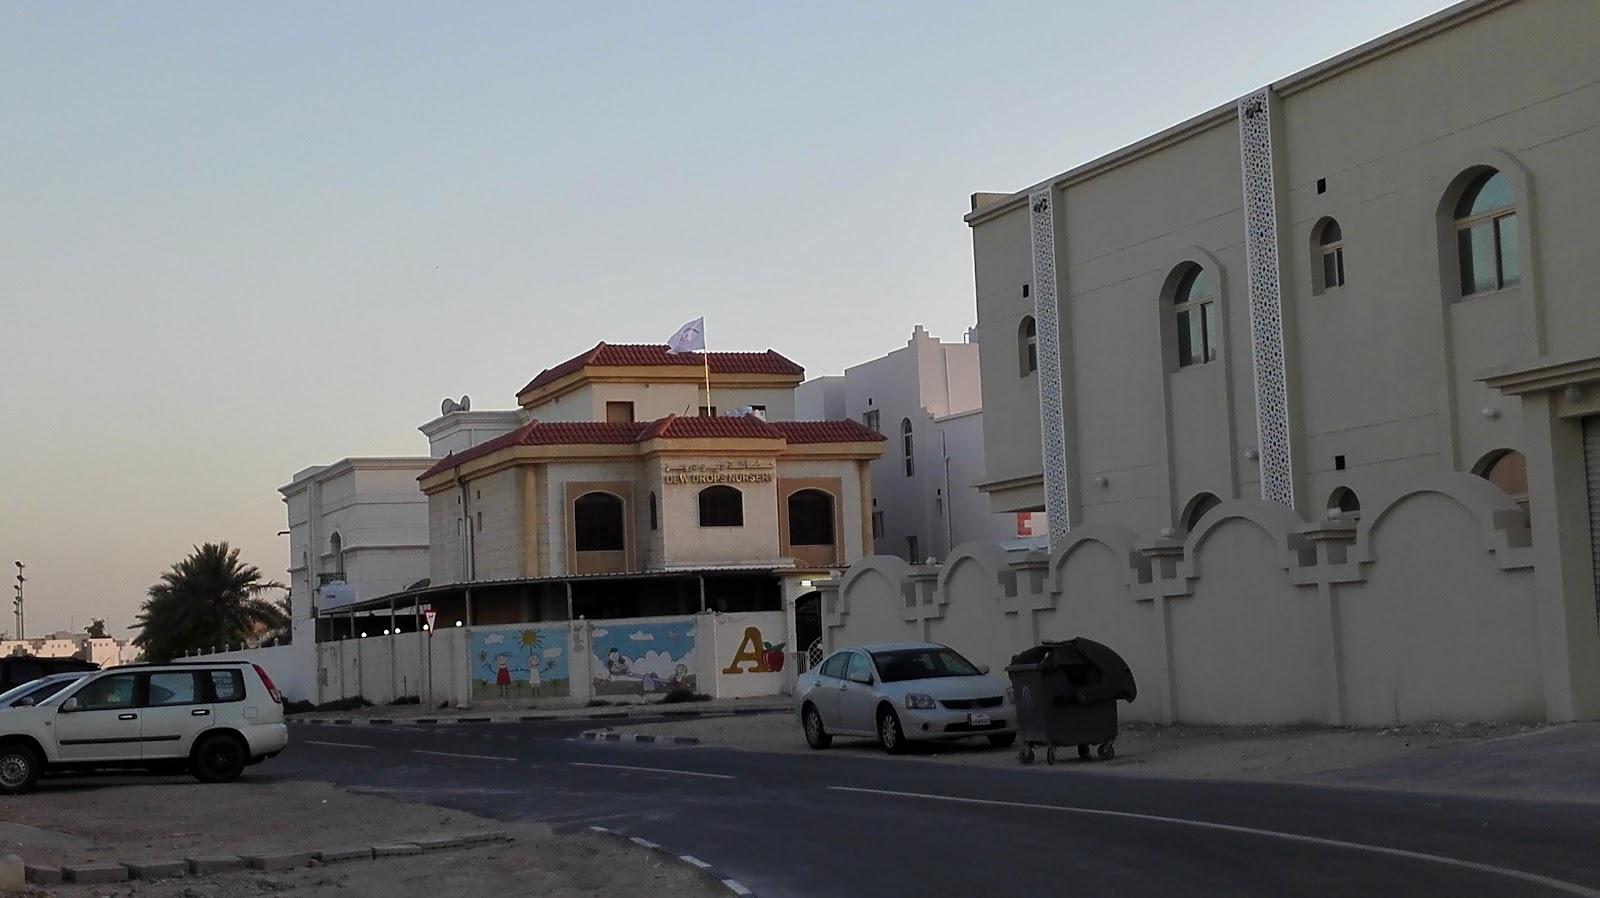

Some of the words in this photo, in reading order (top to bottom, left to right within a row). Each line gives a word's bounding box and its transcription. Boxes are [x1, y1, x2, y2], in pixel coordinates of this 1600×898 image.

[665, 474, 690, 485] DEW
[692, 473, 727, 484] DROPS
[722, 625, 768, 675] A
